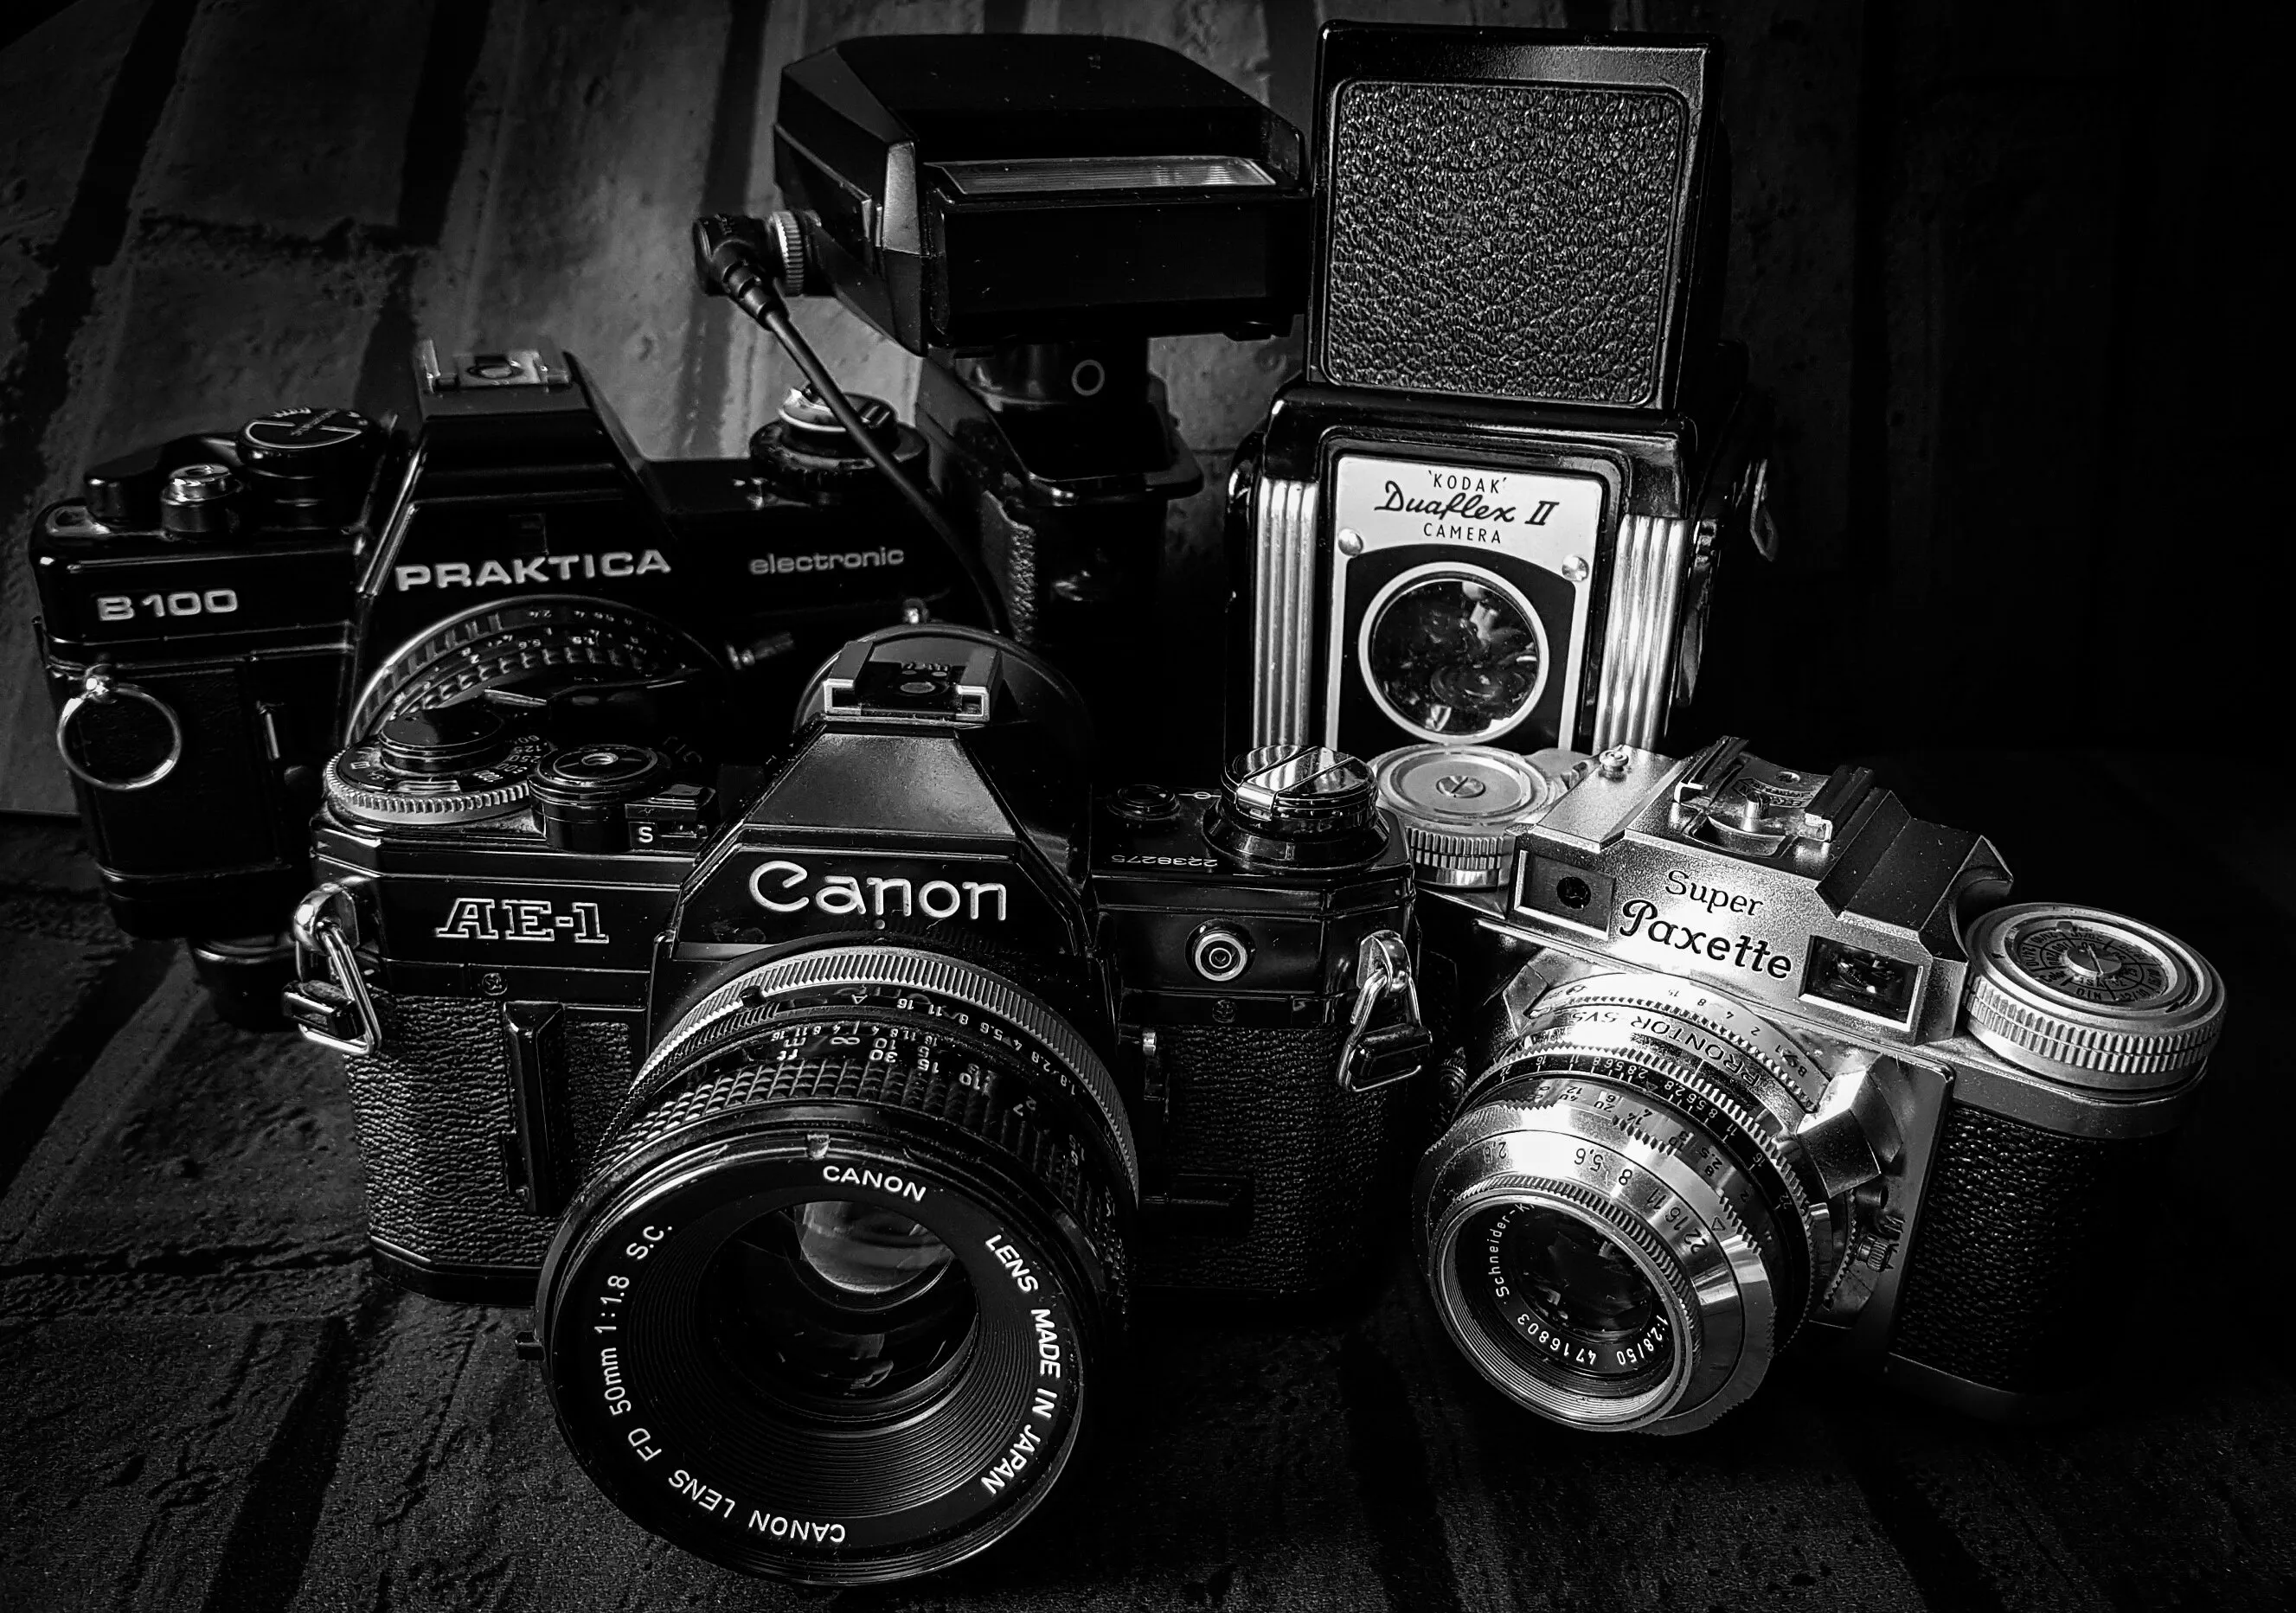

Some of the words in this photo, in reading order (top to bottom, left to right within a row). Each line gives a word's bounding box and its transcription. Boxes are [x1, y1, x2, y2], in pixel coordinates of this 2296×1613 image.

[1374, 479, 1516, 523] Duaflex
[1524, 499, 1559, 527] II
[1423, 522, 1502, 545] CAMERA
[394, 549, 671, 592] PRAKTICA
[748, 545, 905, 576] electronic
[496, 763, 528, 774] 500
[638, 825, 654, 843] S
[1110, 854, 1218, 867] 2238275
[748, 861, 1007, 921] Canon
[1664, 868, 1765, 917] Super
[433, 897, 610, 944] AE-1
[1619, 897, 1793, 979] Paxette
[2040, 970, 2067, 983] Color
[2076, 988, 2102, 1000] DIN
[873, 1038, 897, 1050] 10
[917, 1045, 931, 1059] 5
[889, 1027, 899, 1038] 8
[896, 998, 914, 1010] 16
[928, 1004, 943, 1016] 11
[959, 1014, 969, 1026] 8
[979, 1021, 1004, 1042] 5.6
[1013, 1039, 1023, 1051] 4
[1030, 1051, 1052, 1072] 2.8
[1060, 1075, 1076, 1096] 1.8
[1630, 1015, 1761, 1087] PRONTOR
[1751, 1027, 1760, 1036] 2
[1798, 1066, 1808, 1078] B
[869, 1049, 899, 1063] 30
[916, 1058, 940, 1074] 15
[959, 1072, 981, 1091] 10
[1536, 1055, 1547, 1066] 16
[1569, 1054, 1580, 1064] 11
[1593, 1057, 1600, 1066] 8
[1567, 1086, 1583, 1095] 12
[1605, 1094, 1616, 1104] 6
[1643, 1109, 1653, 1118] 4
[1678, 1130, 1690, 1142] 3
[1740, 1190, 1749, 1203] 2
[1594, 1101, 1615, 1113] 20
[1704, 1165, 1715, 1177] 8
[1709, 1108, 1718, 1118] 8
[1753, 1152, 1766, 1168] 16
[822, 1165, 927, 1204] CANON
[1618, 1168, 1633, 1186] 8
[1646, 1188, 1666, 1210] 11
[1664, 1207, 1689, 1231] 16
[1684, 1227, 1710, 1254] 22
[625, 1222, 674, 1261] S.C.
[984, 1233, 1039, 1295] LENS
[593, 1274, 631, 1334] 1:1.8
[1030, 1308, 1061, 1379] MADE
[1517, 1313, 1597, 1366] 4716803
[601, 1345, 632, 1417] 50mm
[1033, 1389, 1059, 1419] IN
[627, 1427, 664, 1463] FD
[981, 1422, 1042, 1495] JAPAN
[668, 1468, 736, 1522] LENS
[749, 1508, 847, 1543] CANON
